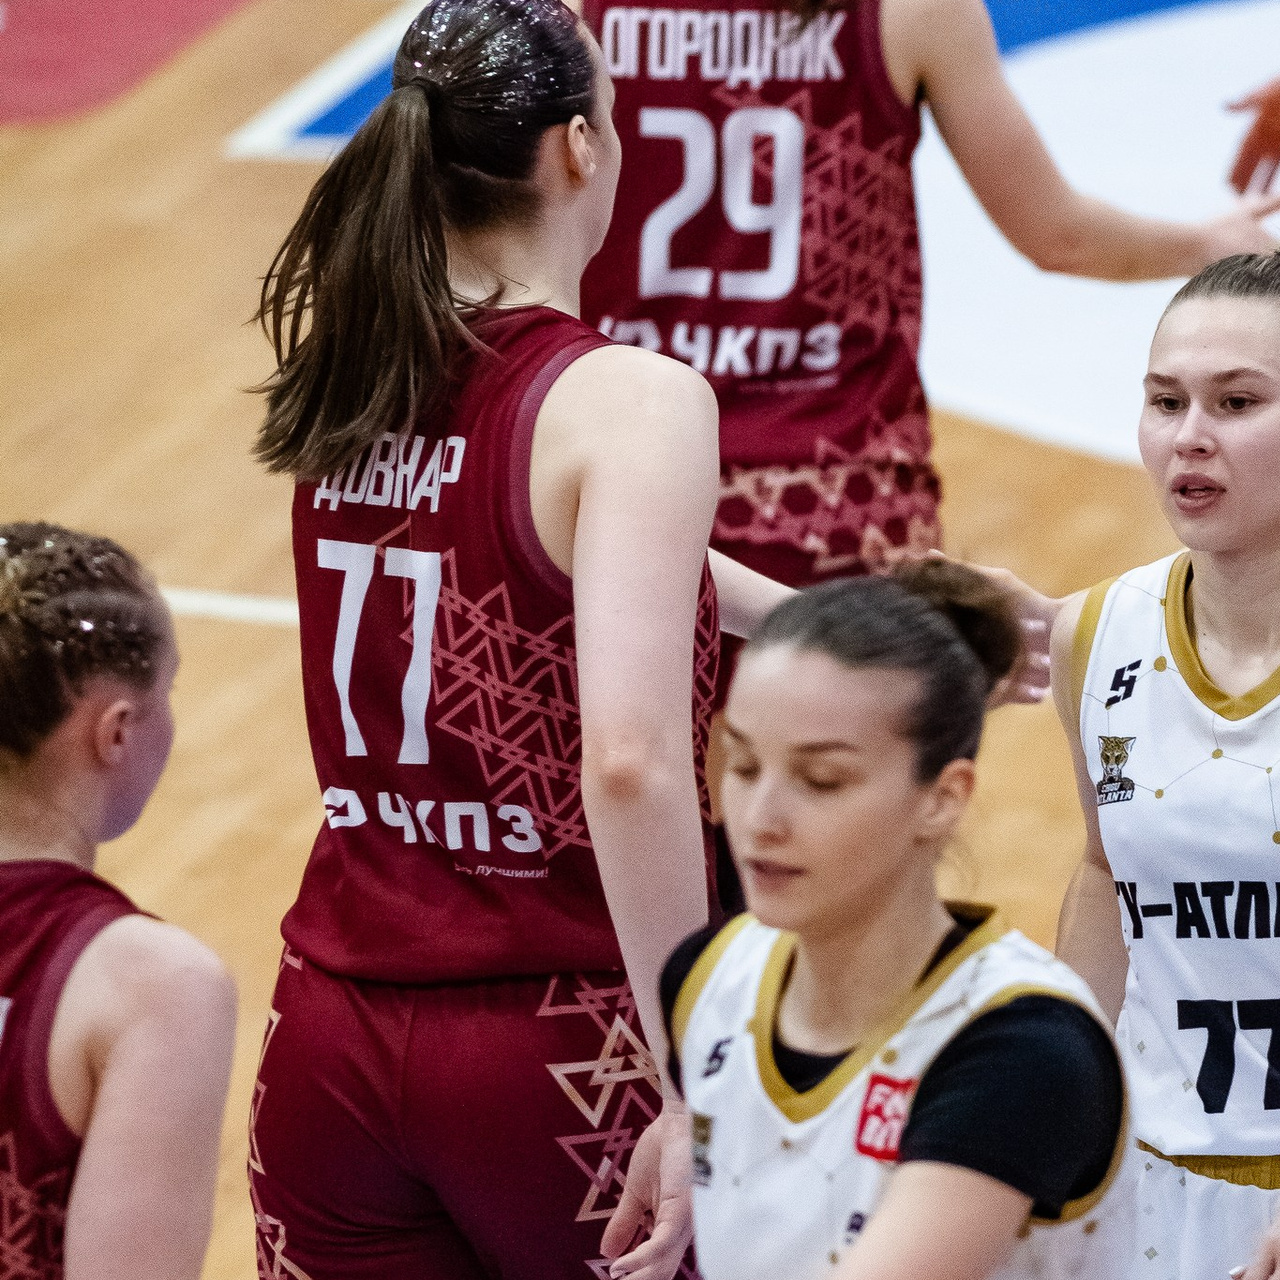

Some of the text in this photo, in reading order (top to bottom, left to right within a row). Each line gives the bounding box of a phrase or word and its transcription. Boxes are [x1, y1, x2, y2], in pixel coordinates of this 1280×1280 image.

[603, 6, 848, 89] ОГОРОДНИК
[638, 106, 805, 301] 29
[313, 431, 467, 514] ДОВНАР
[316, 537, 442, 765] 77
